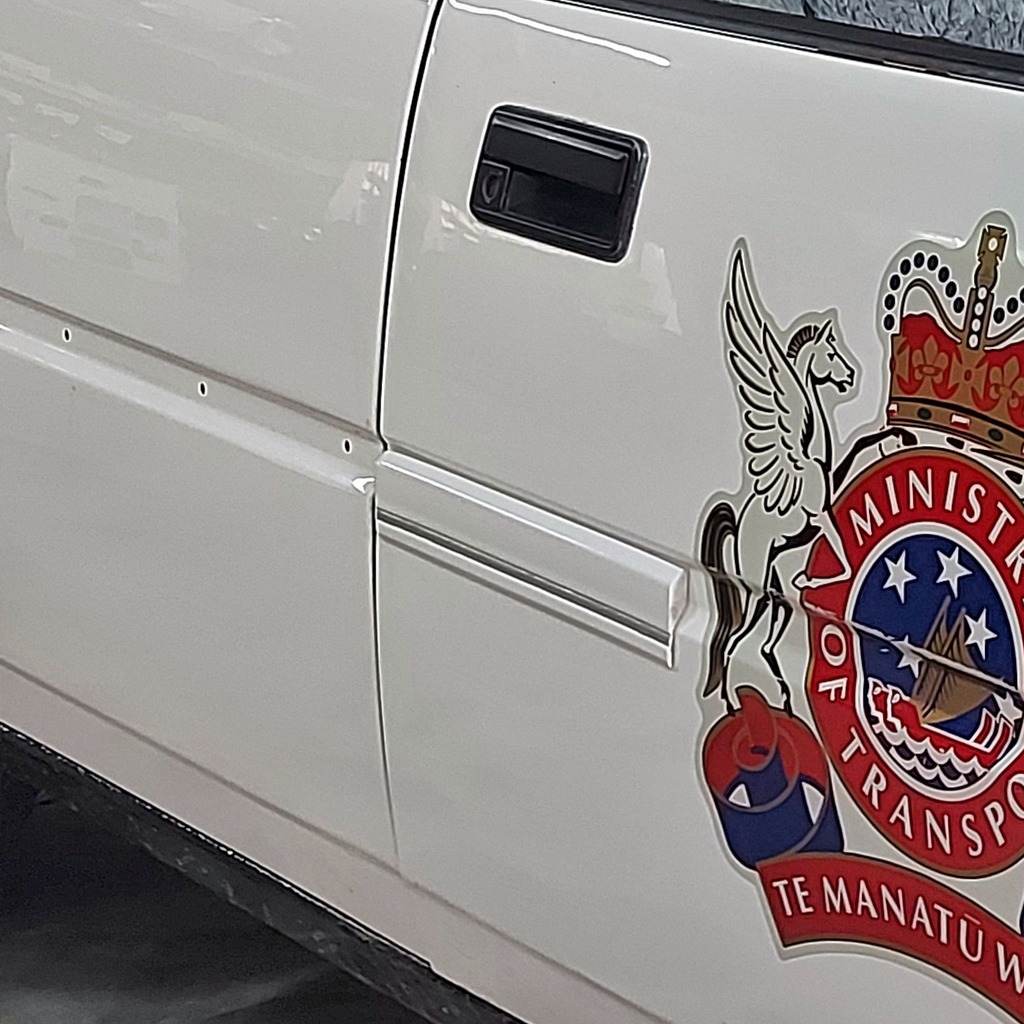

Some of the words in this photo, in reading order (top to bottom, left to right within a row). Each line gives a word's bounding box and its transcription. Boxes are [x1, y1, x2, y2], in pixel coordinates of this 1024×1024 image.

[818, 623, 848, 702] OF
[772, 876, 814, 916] TE
[822, 875, 983, 963] MANATŪ
